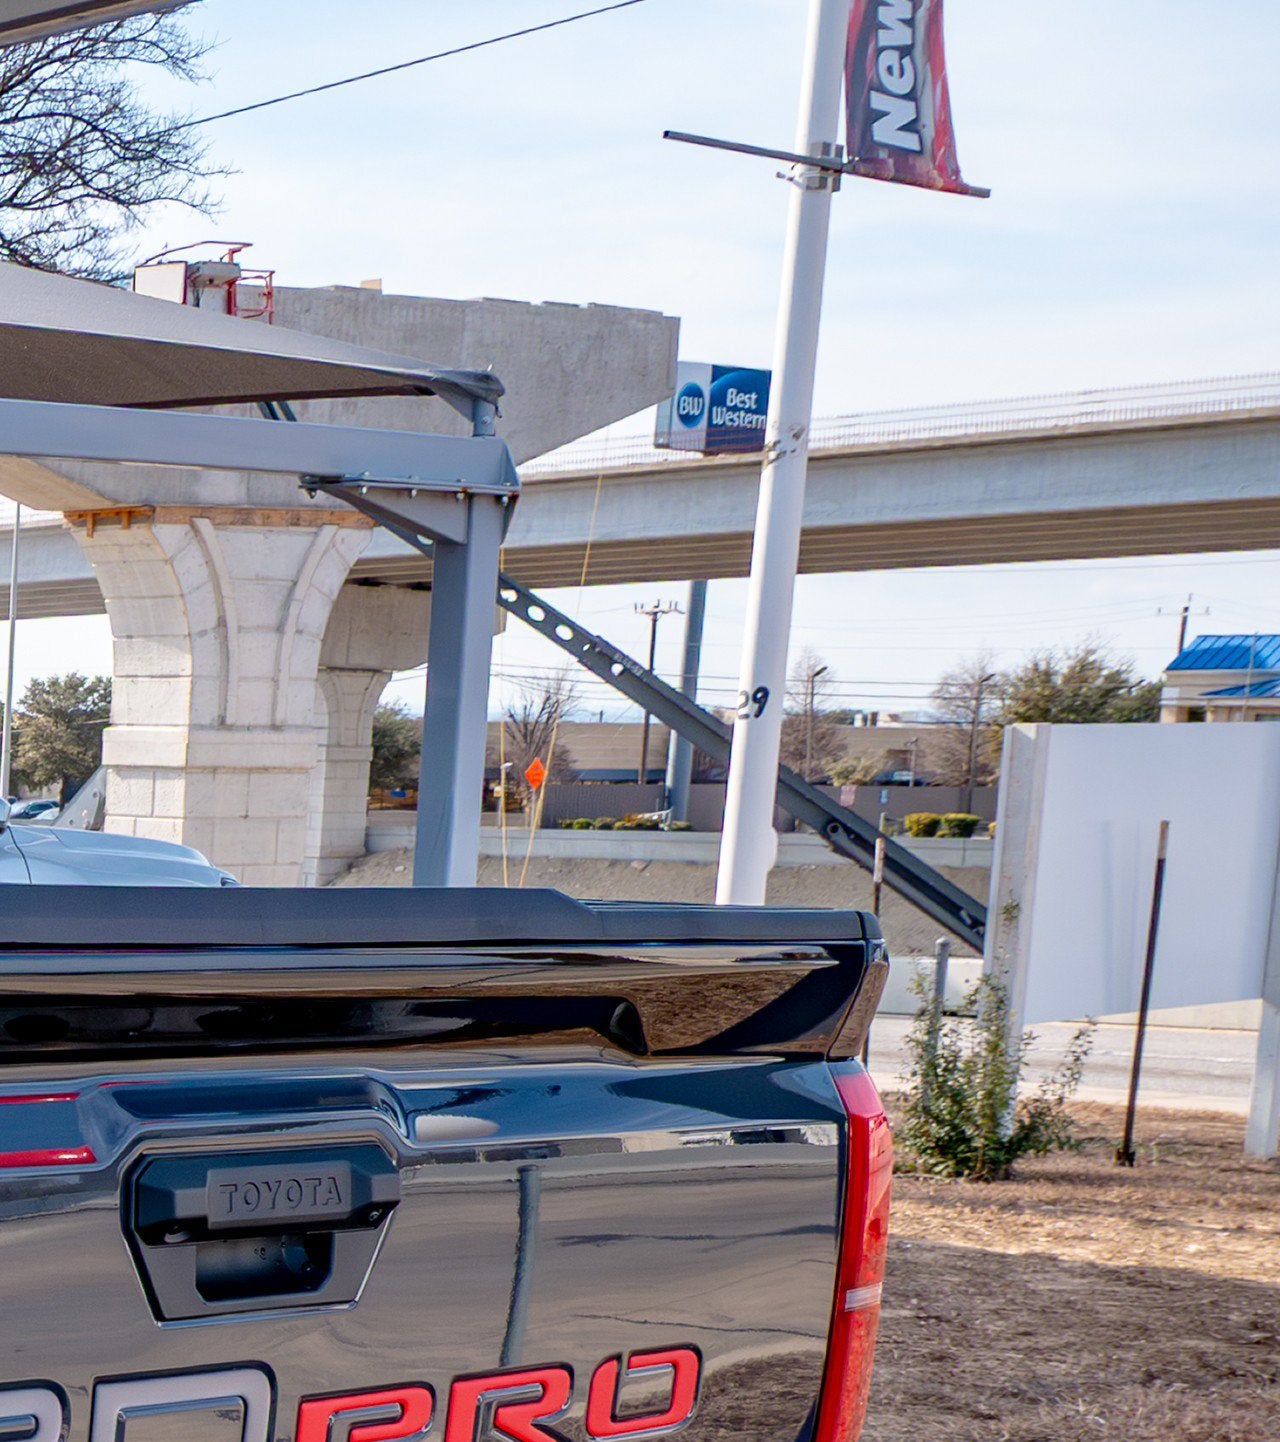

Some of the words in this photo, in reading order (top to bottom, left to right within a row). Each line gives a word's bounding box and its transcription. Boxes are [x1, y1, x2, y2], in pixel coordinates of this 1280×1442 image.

[680, 396, 703, 416] BW
[726, 388, 757, 410] Best
[712, 406, 767, 430] Western
[219, 1176, 343, 1214] TOYOTA
